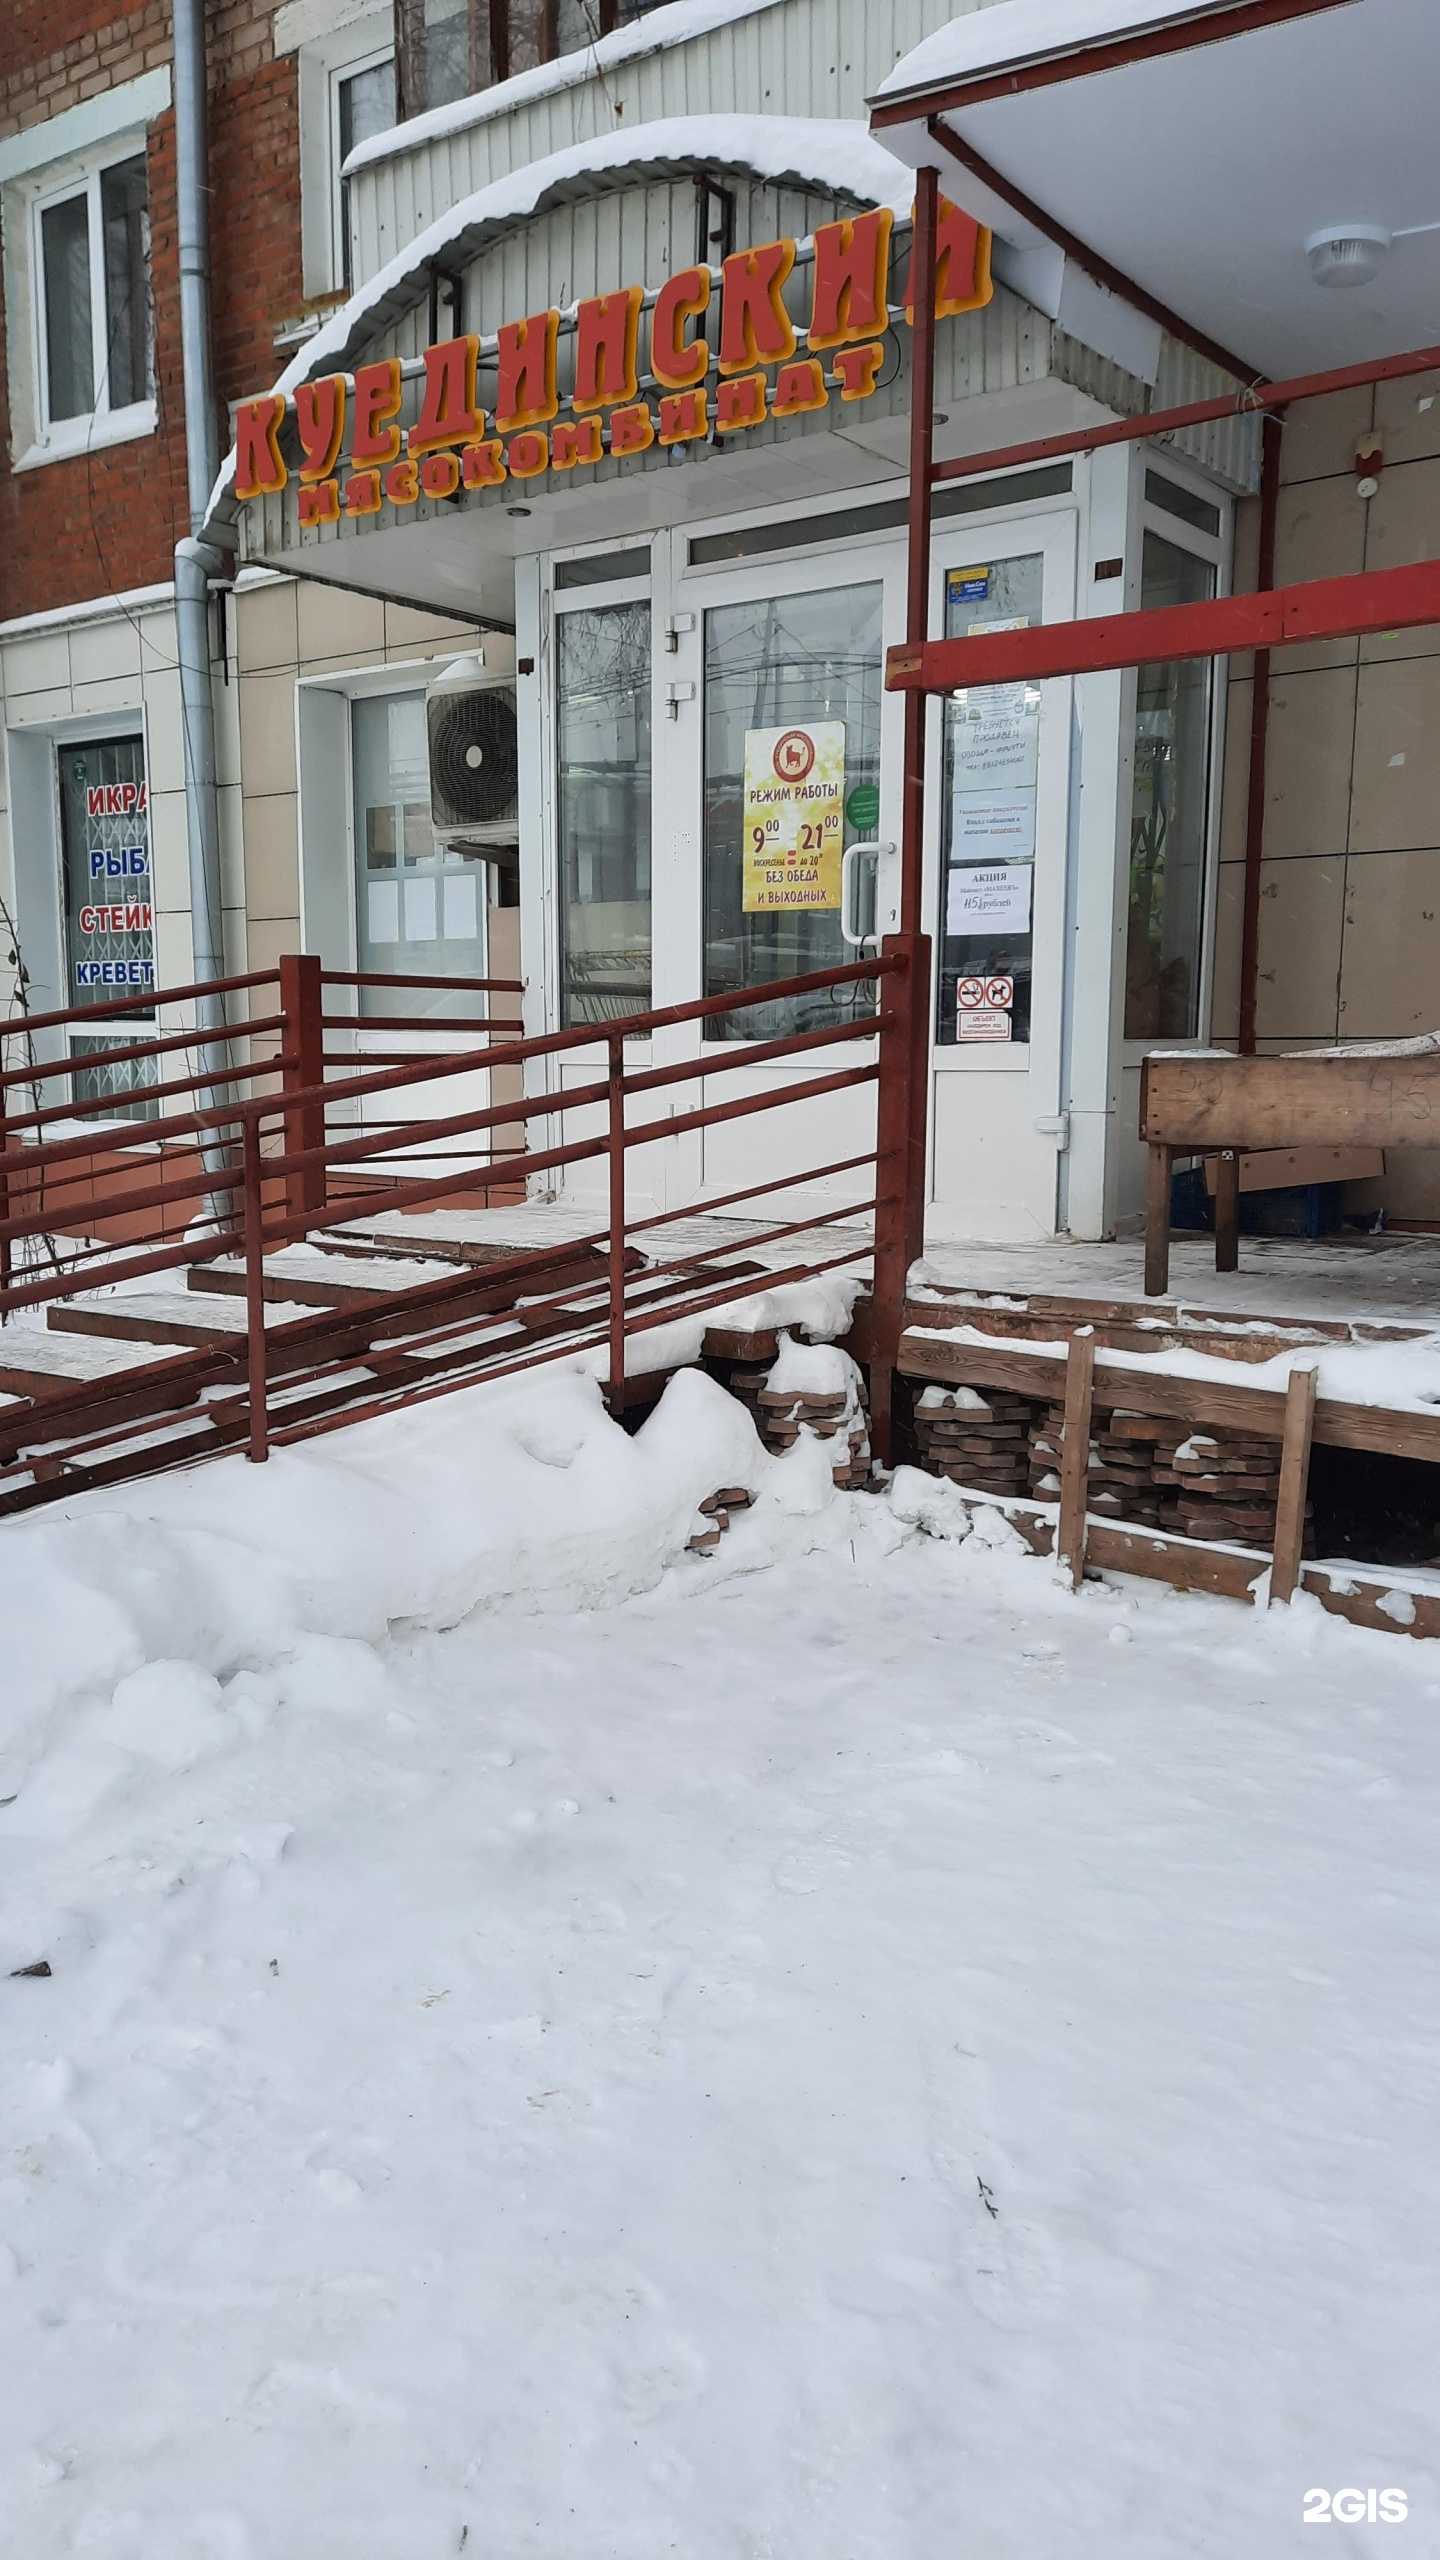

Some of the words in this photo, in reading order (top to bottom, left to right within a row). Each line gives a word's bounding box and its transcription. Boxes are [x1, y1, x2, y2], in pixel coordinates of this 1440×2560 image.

[296, 341, 884, 528] МЯСОКОМБИНАТ
[750, 787, 791, 803] РЕЖИМ
[795, 784, 839, 799] РАБОТЫ
[90, 845, 151, 879] РЫБ
[766, 871, 784, 883] БЕЗ
[787, 869, 819, 882] ОБЕДА
[972, 872, 1008, 883] АКЦИЯ
[758, 892, 765, 904] И
[768, 890, 827, 904] ВЫХОДНЫХ
[76, 959, 154, 986] КРЕВЕТ
